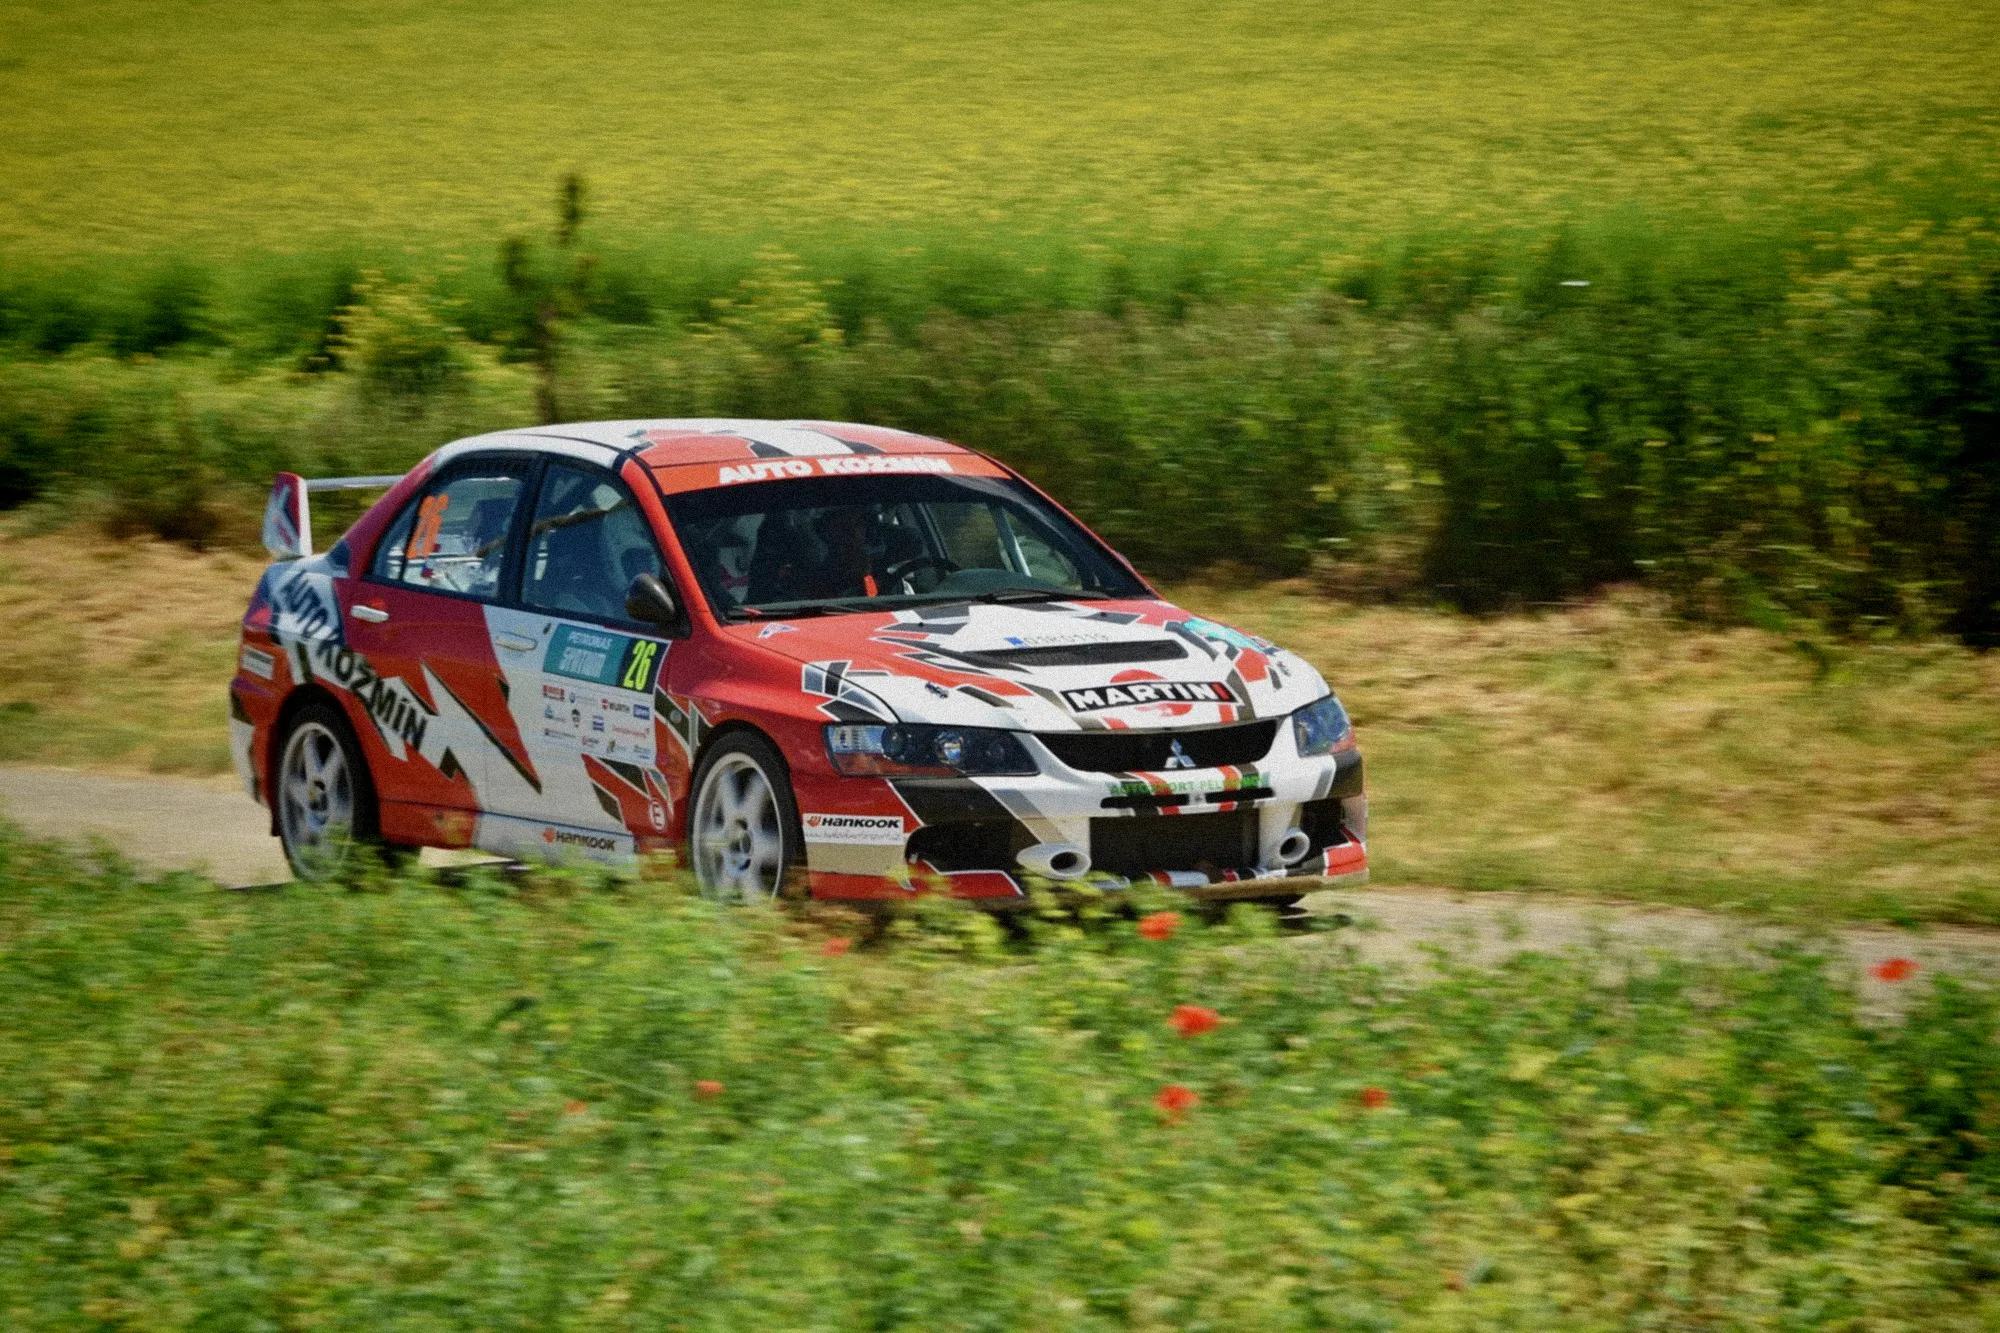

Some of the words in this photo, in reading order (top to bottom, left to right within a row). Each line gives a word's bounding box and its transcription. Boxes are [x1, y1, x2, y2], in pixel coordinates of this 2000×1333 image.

[719, 460, 813, 485] AUTO
[623, 639, 658, 690] 26
[1067, 682, 1231, 711] MARTINI
